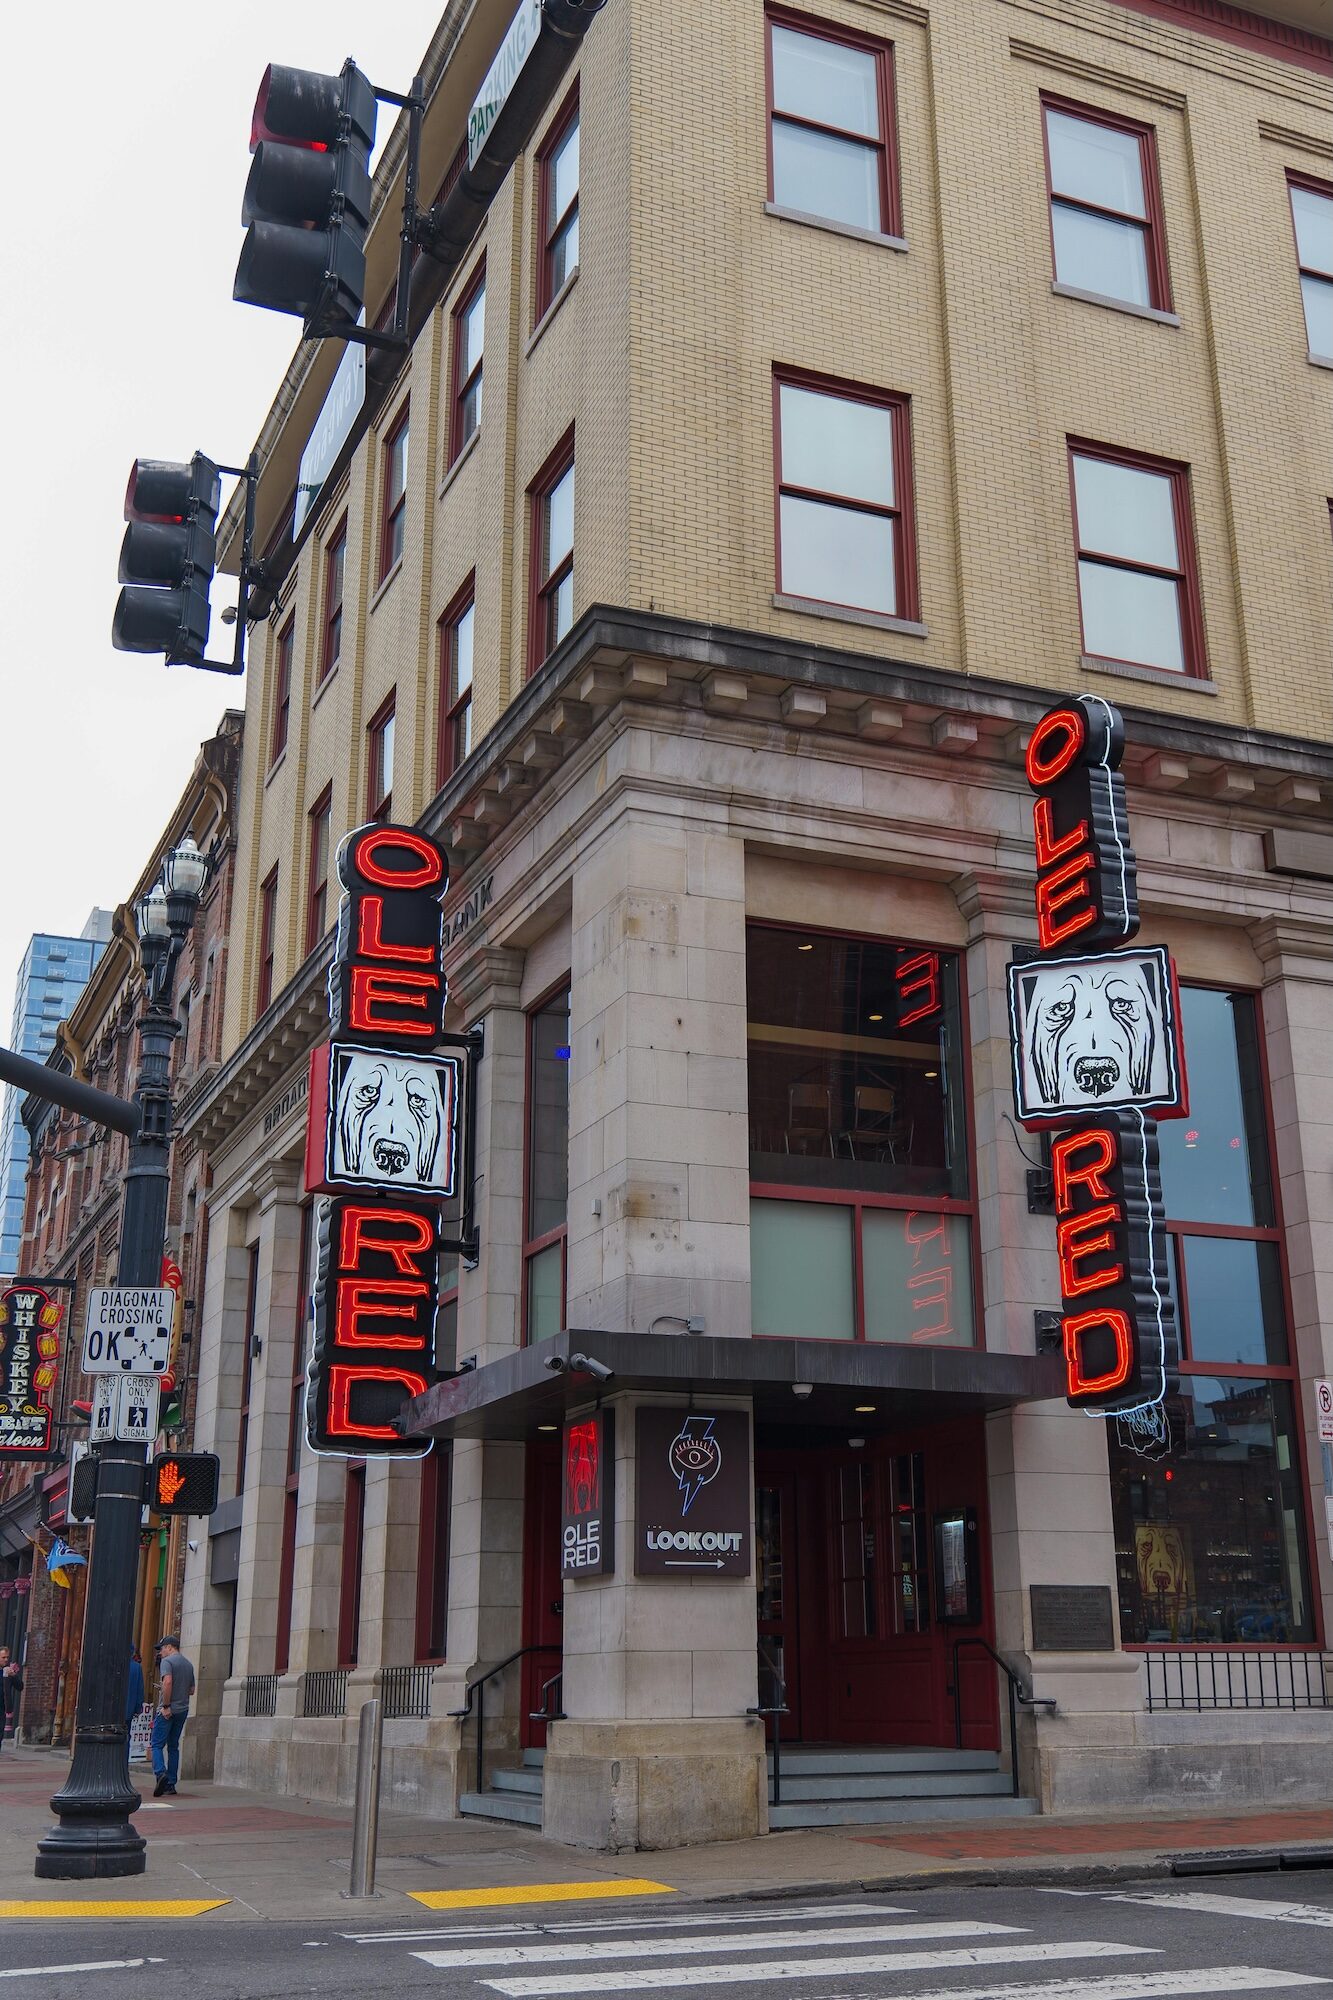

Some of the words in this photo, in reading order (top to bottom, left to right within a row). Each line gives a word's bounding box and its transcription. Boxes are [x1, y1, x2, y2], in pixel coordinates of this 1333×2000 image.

[469, 14, 527, 160] PARKING
[1025, 709, 1097, 952] OLE
[349, 828, 444, 1037] OLE
[264, 1072, 309, 1136] BROAD
[1053, 1128, 1133, 1397] RED
[101, 1291, 165, 1308] DIAGONAL
[100, 1308, 163, 1325] CROSSING
[327, 1205, 435, 1440] RED
[7, 1294, 40, 1413] WHISKEY
[88, 1330, 121, 1361] OK
[99, 1377, 116, 1388] CROSS
[127, 1377, 154, 1388] CROSS
[128, 1387, 151, 1397] ONLY
[99, 1387, 113, 1398] ONLY
[102, 1397, 109, 1407] ON
[133, 1397, 145, 1406] ON
[0, 1430, 44, 1447] aloon
[94, 1428, 111, 1439] SIGNAL
[123, 1428, 150, 1438] SIGNAL
[563, 1520, 600, 1547] OLE
[647, 1530, 742, 1551] LOOKOUT
[563, 1542, 600, 1569] RED
